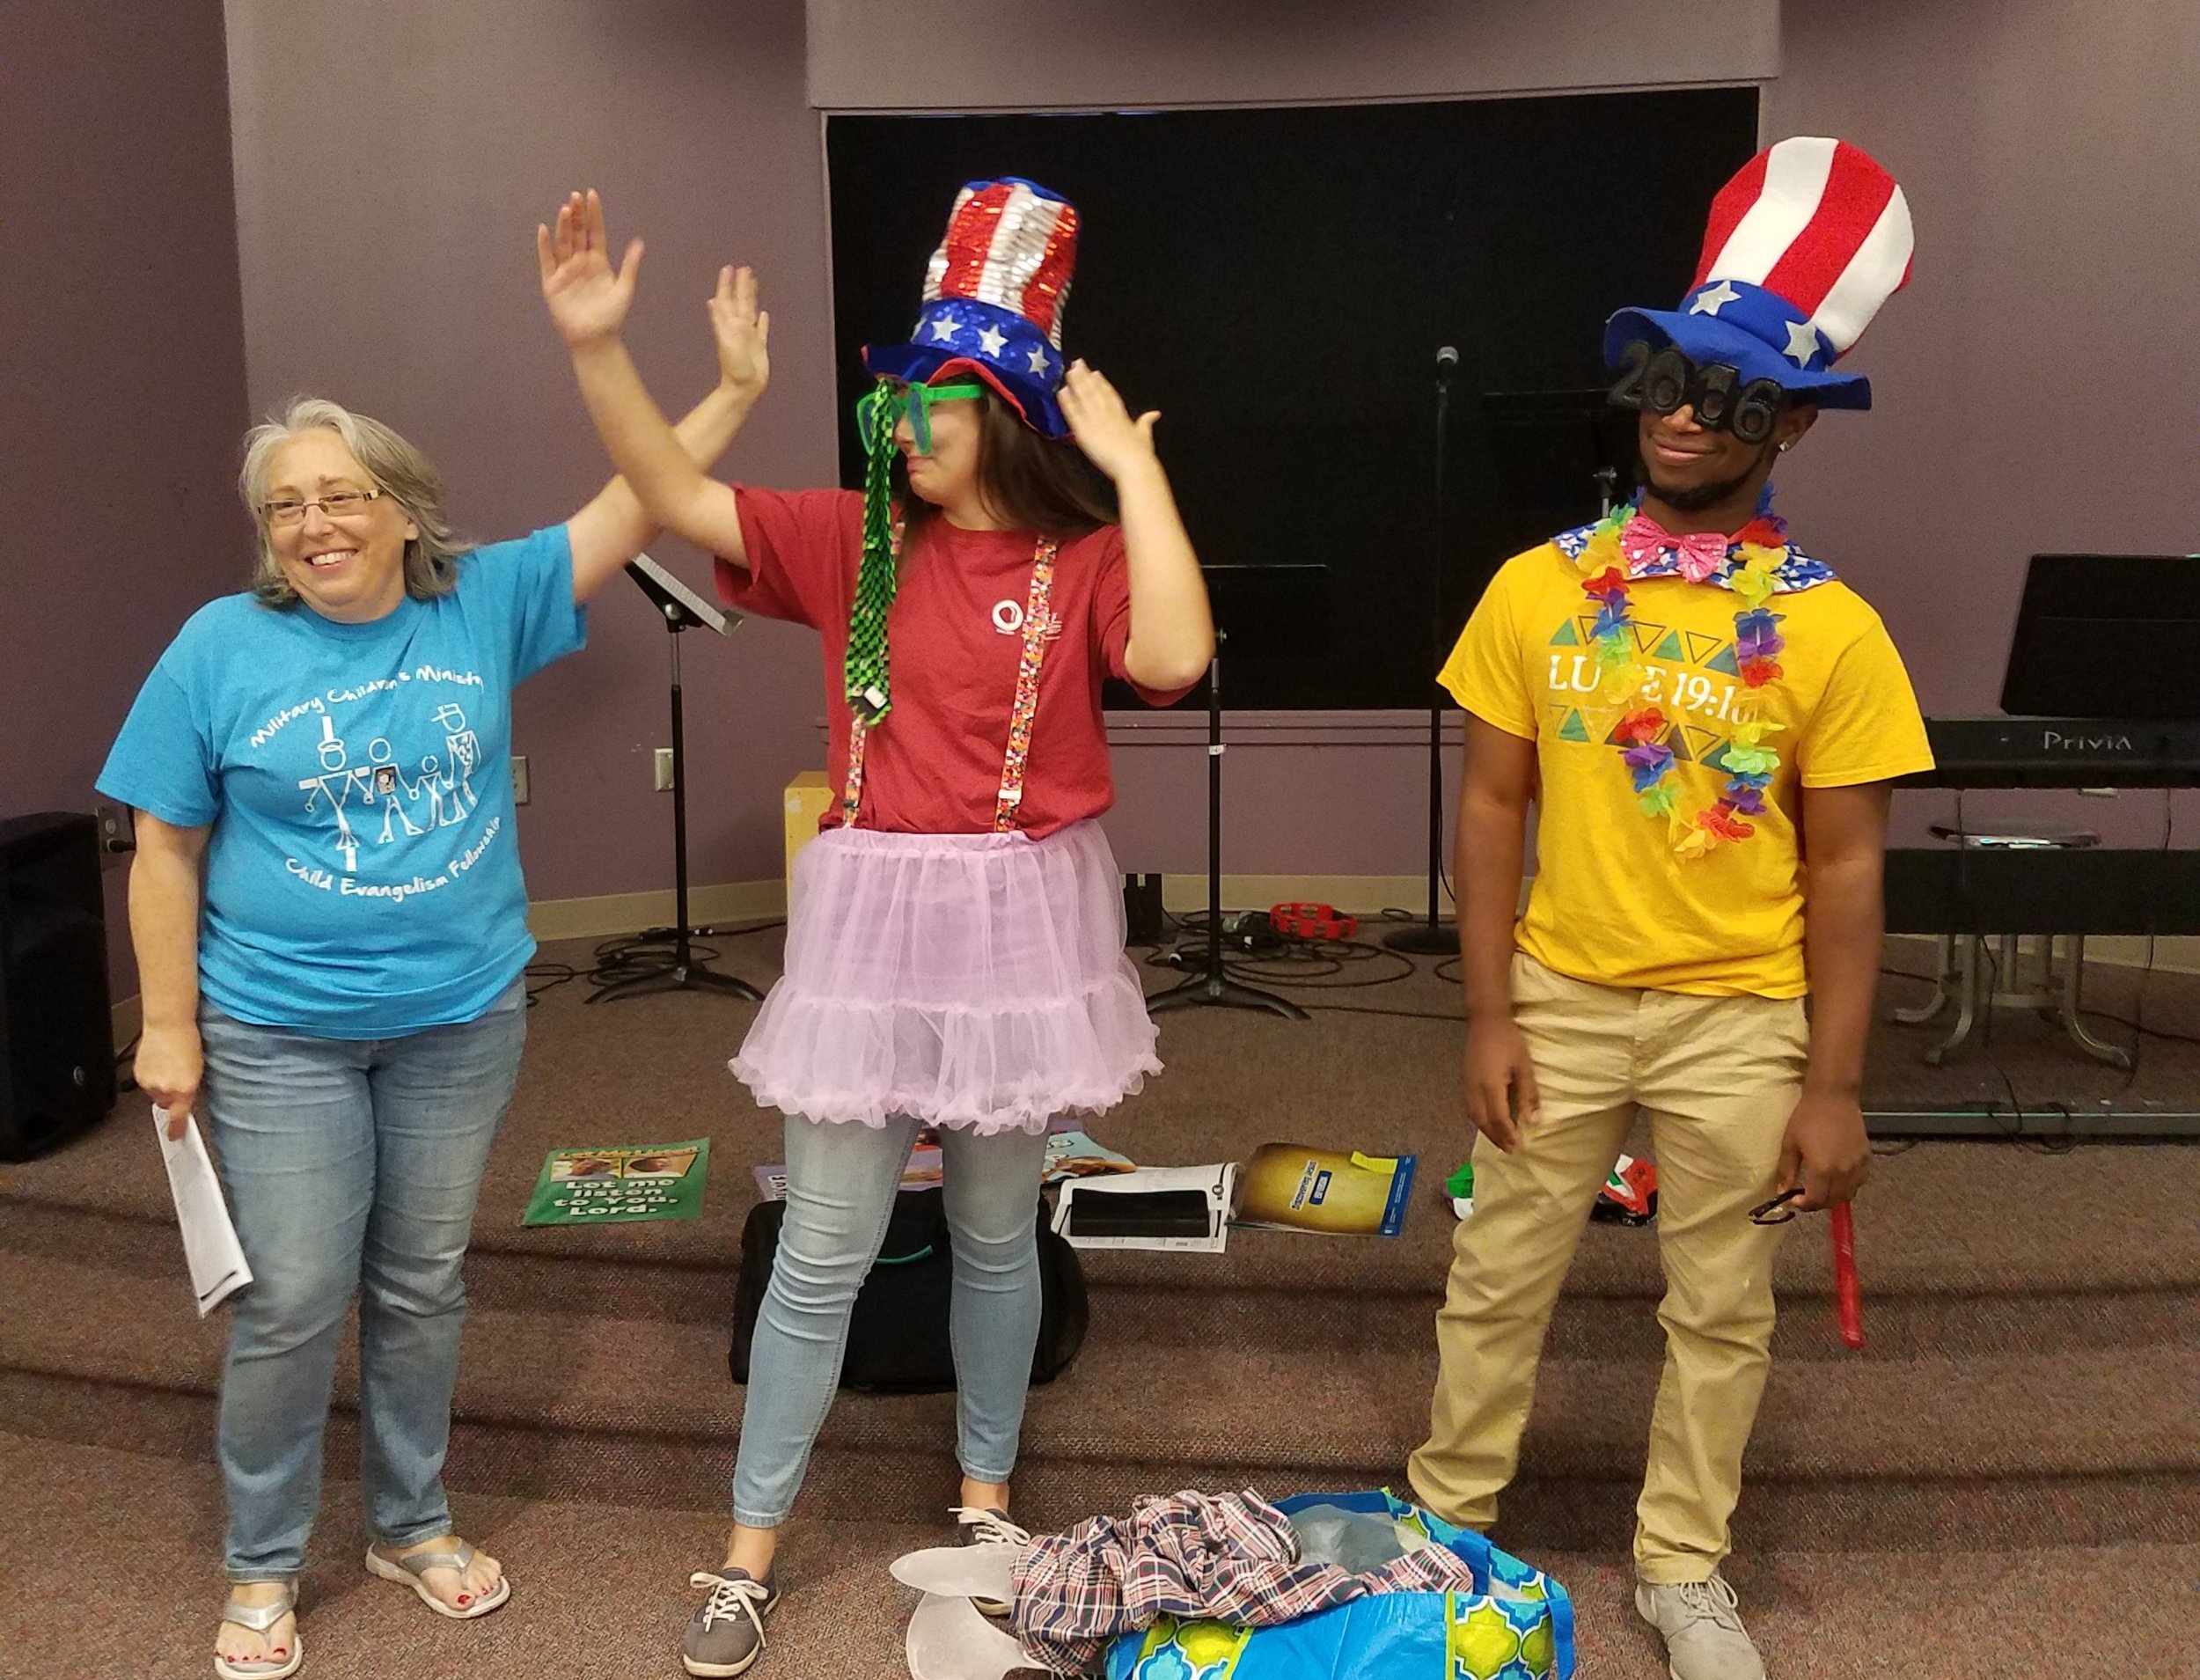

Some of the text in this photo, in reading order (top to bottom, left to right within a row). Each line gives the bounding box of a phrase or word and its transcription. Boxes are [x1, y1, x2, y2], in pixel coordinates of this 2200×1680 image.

[1607, 340, 1784, 444] 2016
[1549, 655, 1667, 702] LUE
[250, 697, 325, 747] Military
[326, 671, 411, 702] Childrens
[286, 817, 500, 902] Child Evangelism Fellowship
[566, 1178, 676, 1190] Let me
[574, 1188, 663, 1198] listen
[554, 1196, 678, 1207] to You,
[569, 1204, 658, 1216] Lord.
